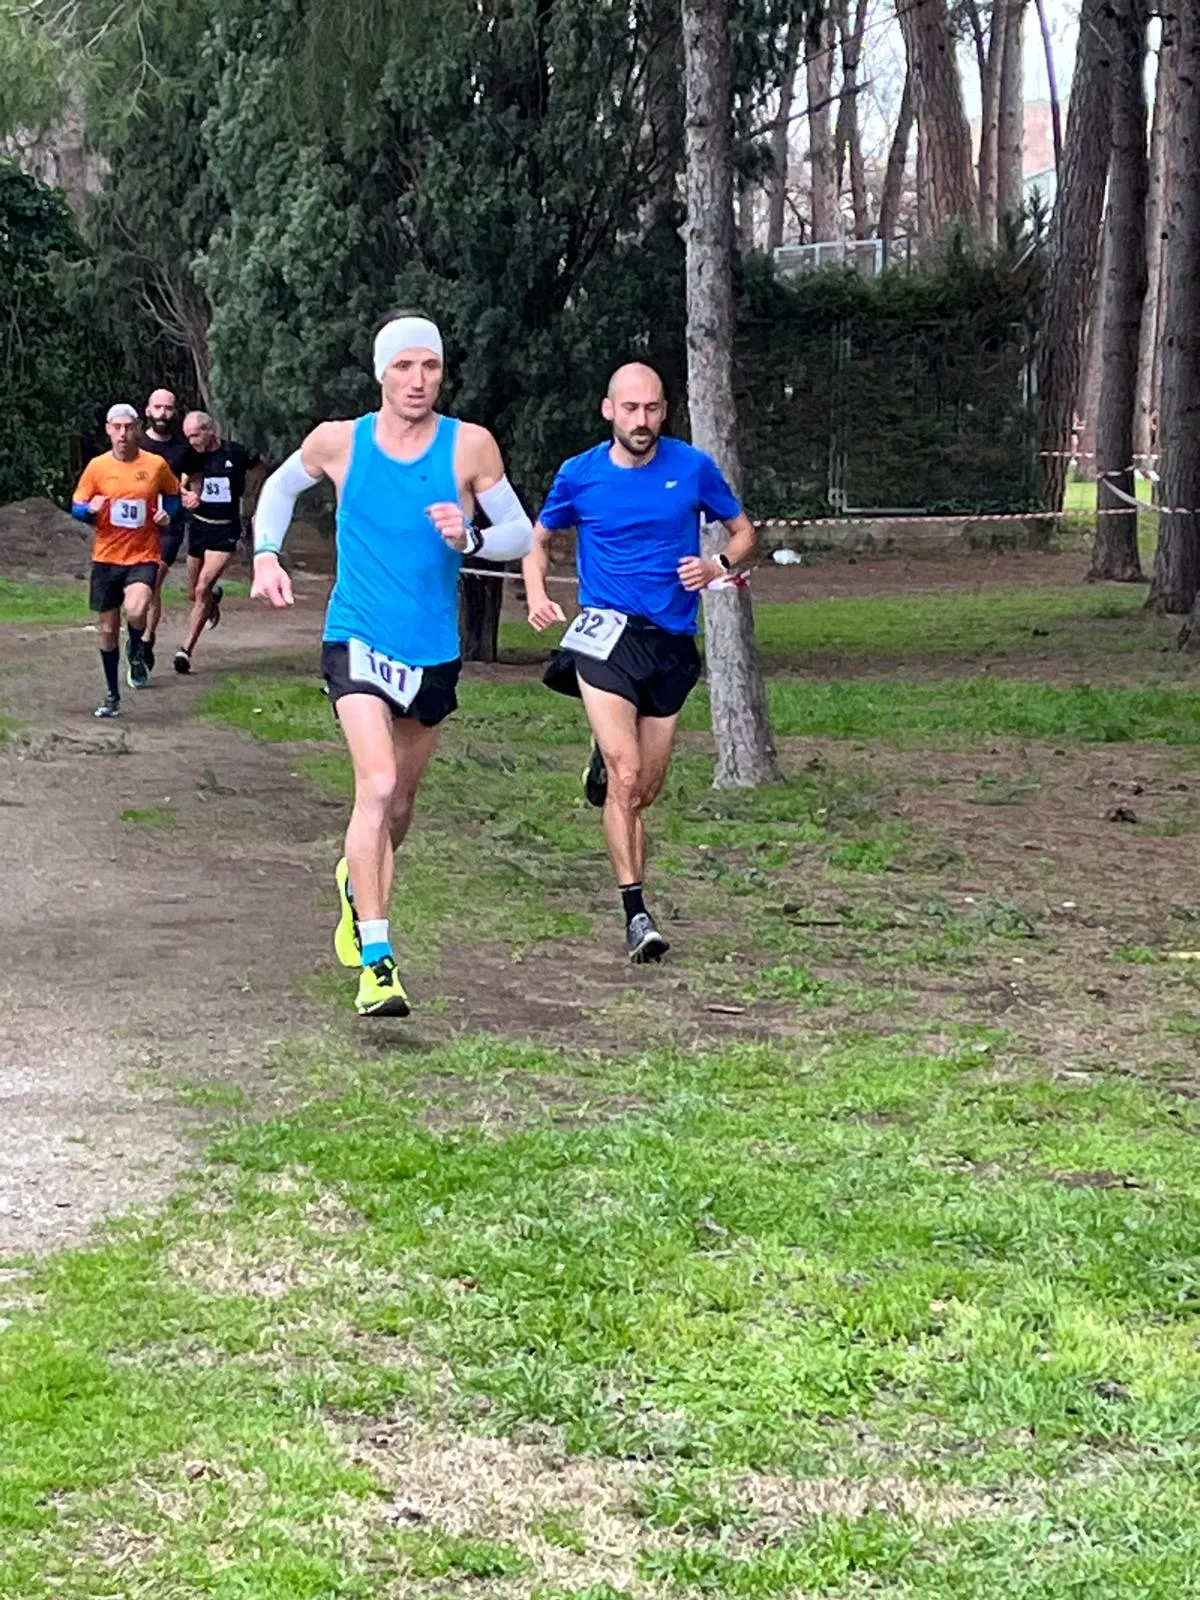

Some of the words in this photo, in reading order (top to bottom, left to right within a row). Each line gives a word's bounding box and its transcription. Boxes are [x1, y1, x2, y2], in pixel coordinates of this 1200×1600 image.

[121, 503, 138, 519] 30
[574, 609, 604, 639] 32
[366, 653, 406, 692] 101
